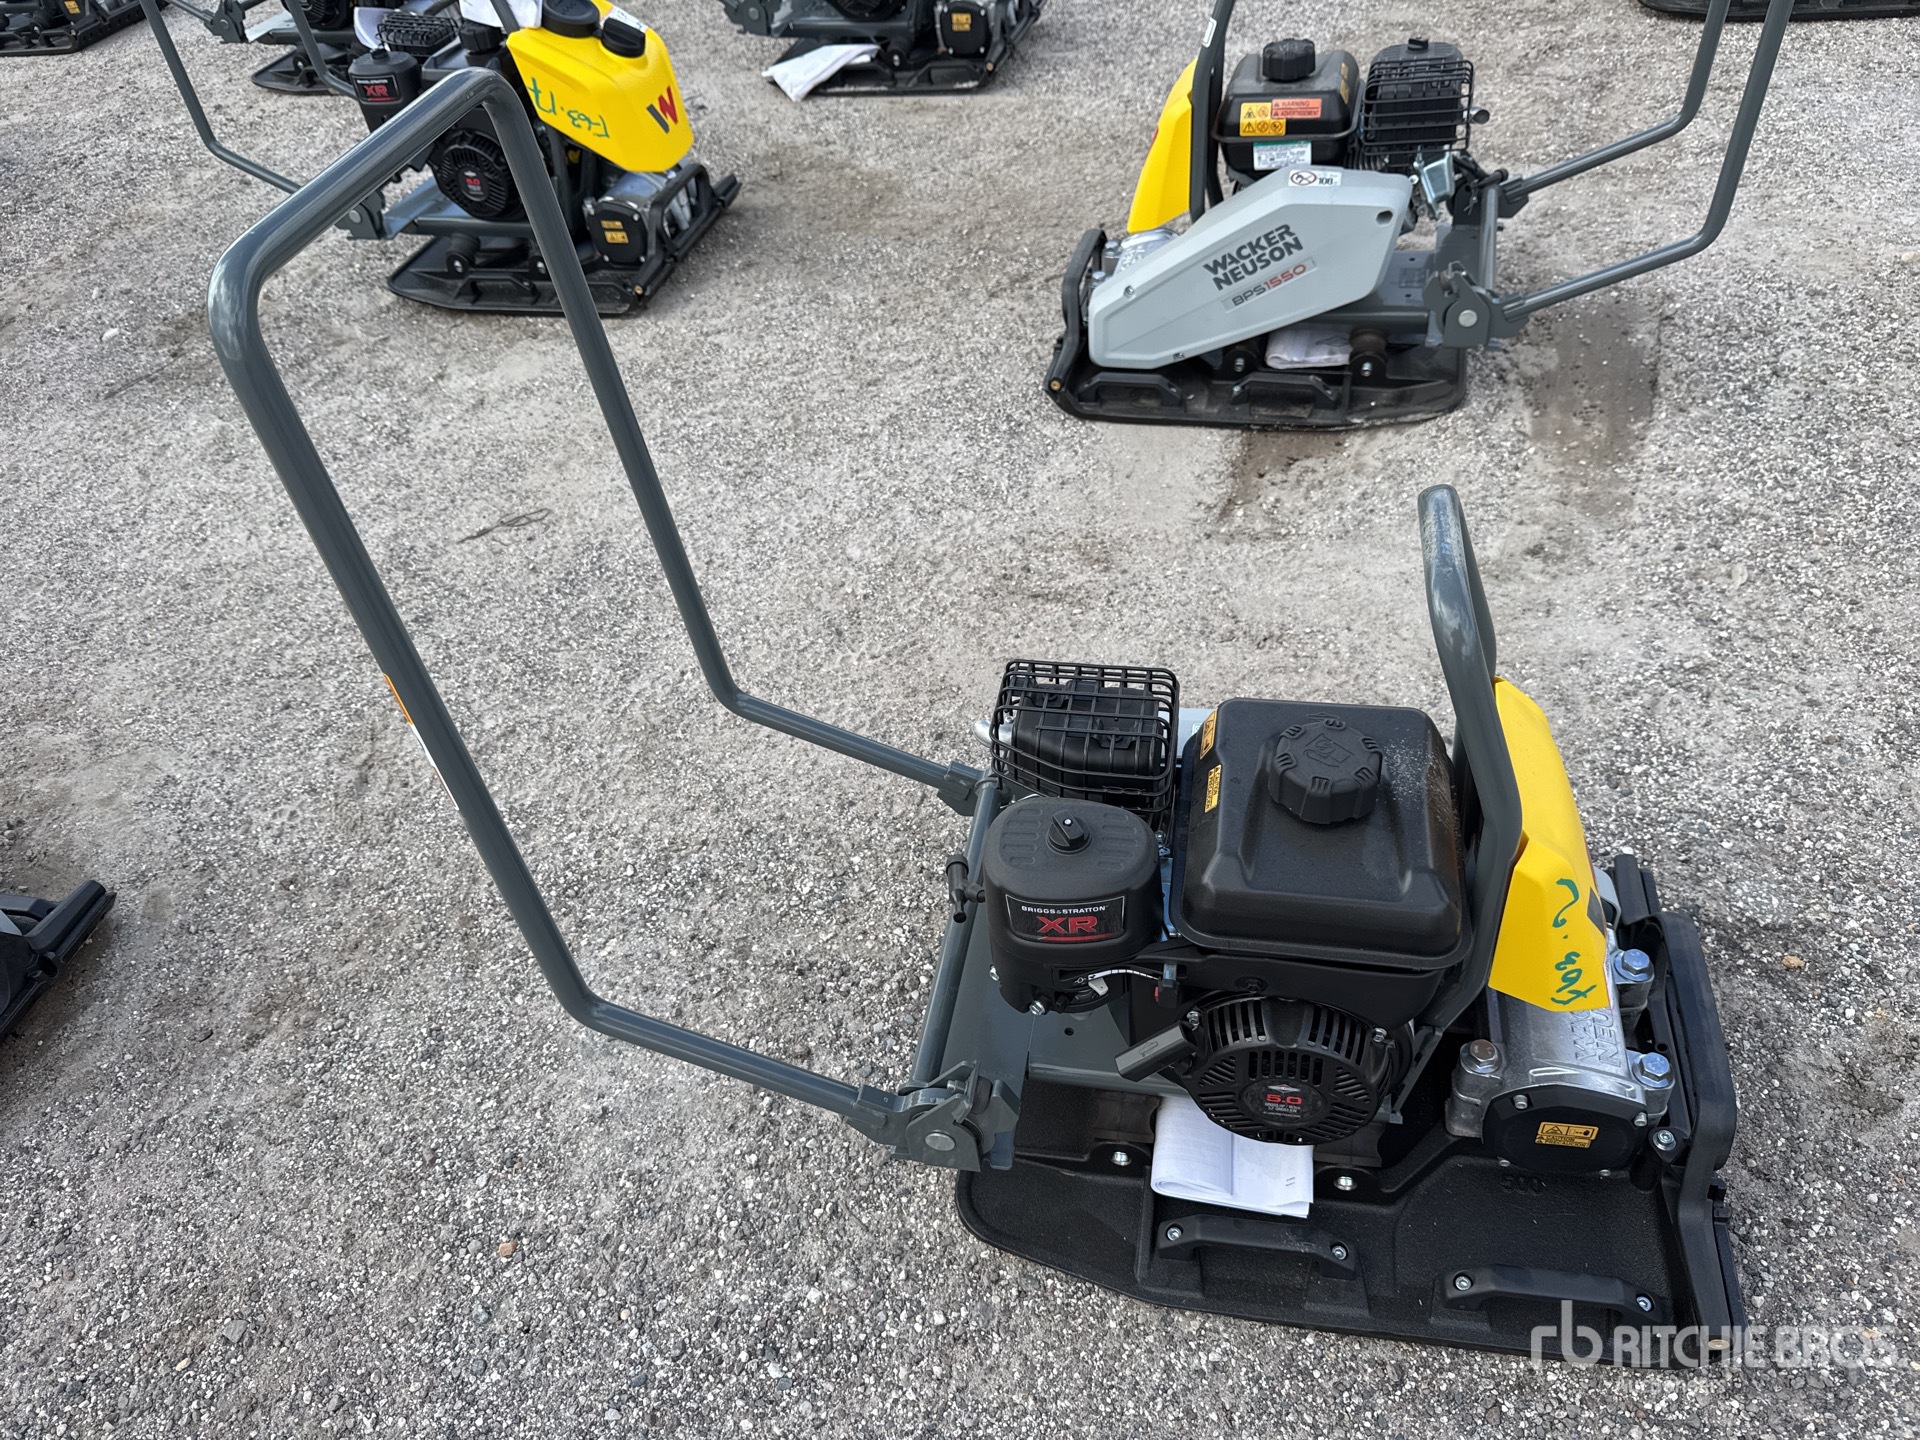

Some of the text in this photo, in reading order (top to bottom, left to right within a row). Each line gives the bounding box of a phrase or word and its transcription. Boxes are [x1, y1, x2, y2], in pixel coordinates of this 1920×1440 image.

[363, 85, 389, 97] XR
[1202, 224, 1296, 275] WACKER
[1212, 236, 1304, 291] NEUSON
[1231, 263, 1307, 307] BPS1550
[1035, 915, 1098, 935] XR
[1266, 1094, 1302, 1104] 5.0
